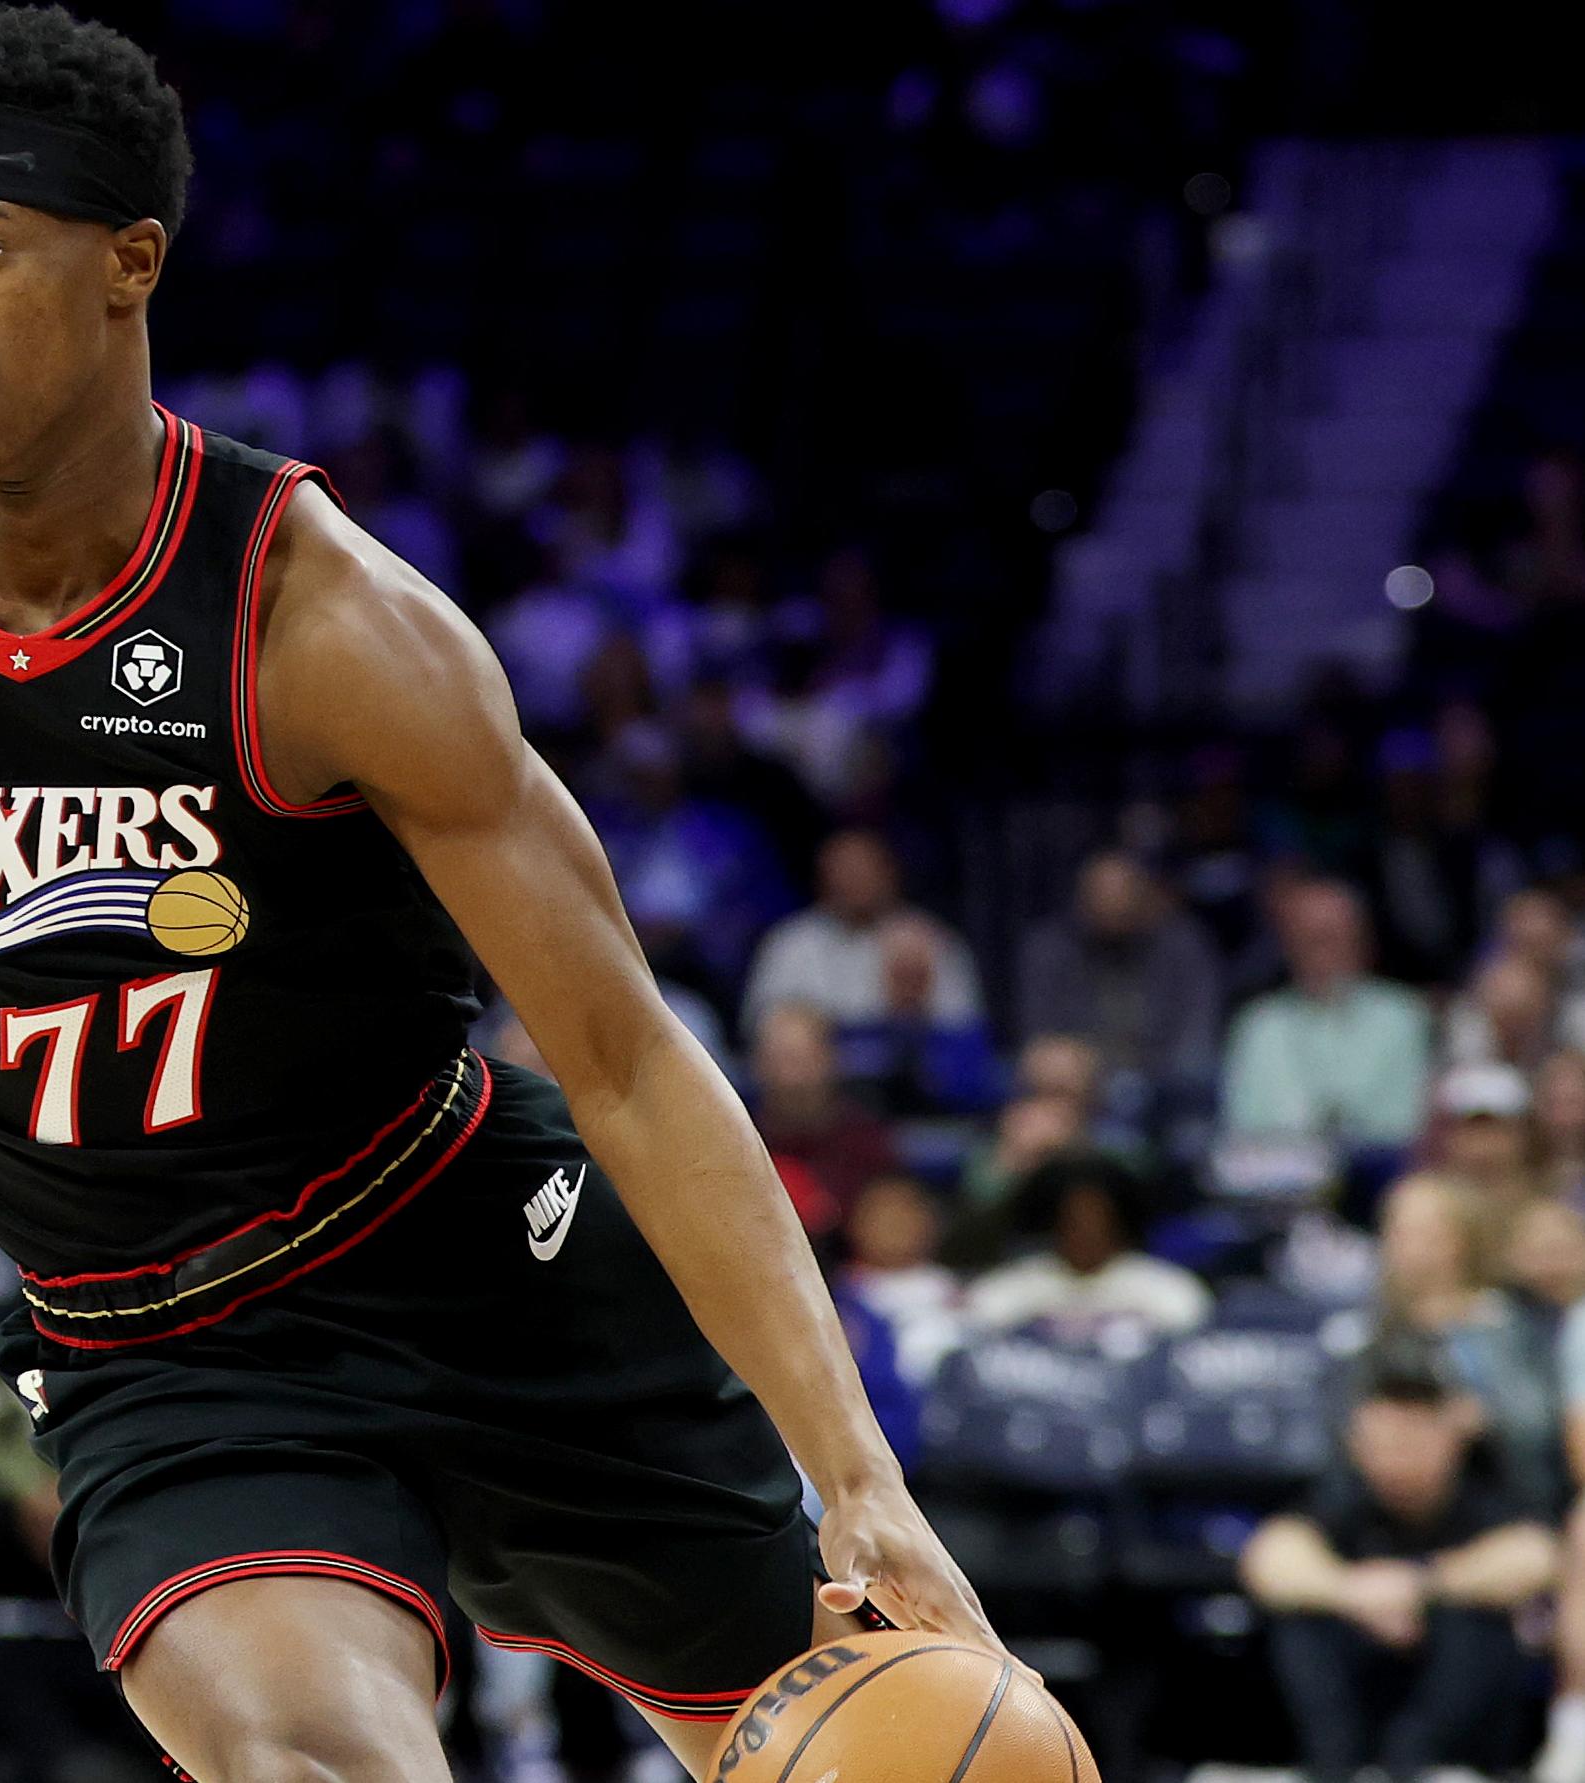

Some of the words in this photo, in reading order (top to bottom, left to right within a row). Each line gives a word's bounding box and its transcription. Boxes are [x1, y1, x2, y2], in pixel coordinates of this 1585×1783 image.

[80, 715, 206, 739] crypto.com
[0, 966, 221, 1146] 77
[523, 1167, 575, 1238] NIKE
